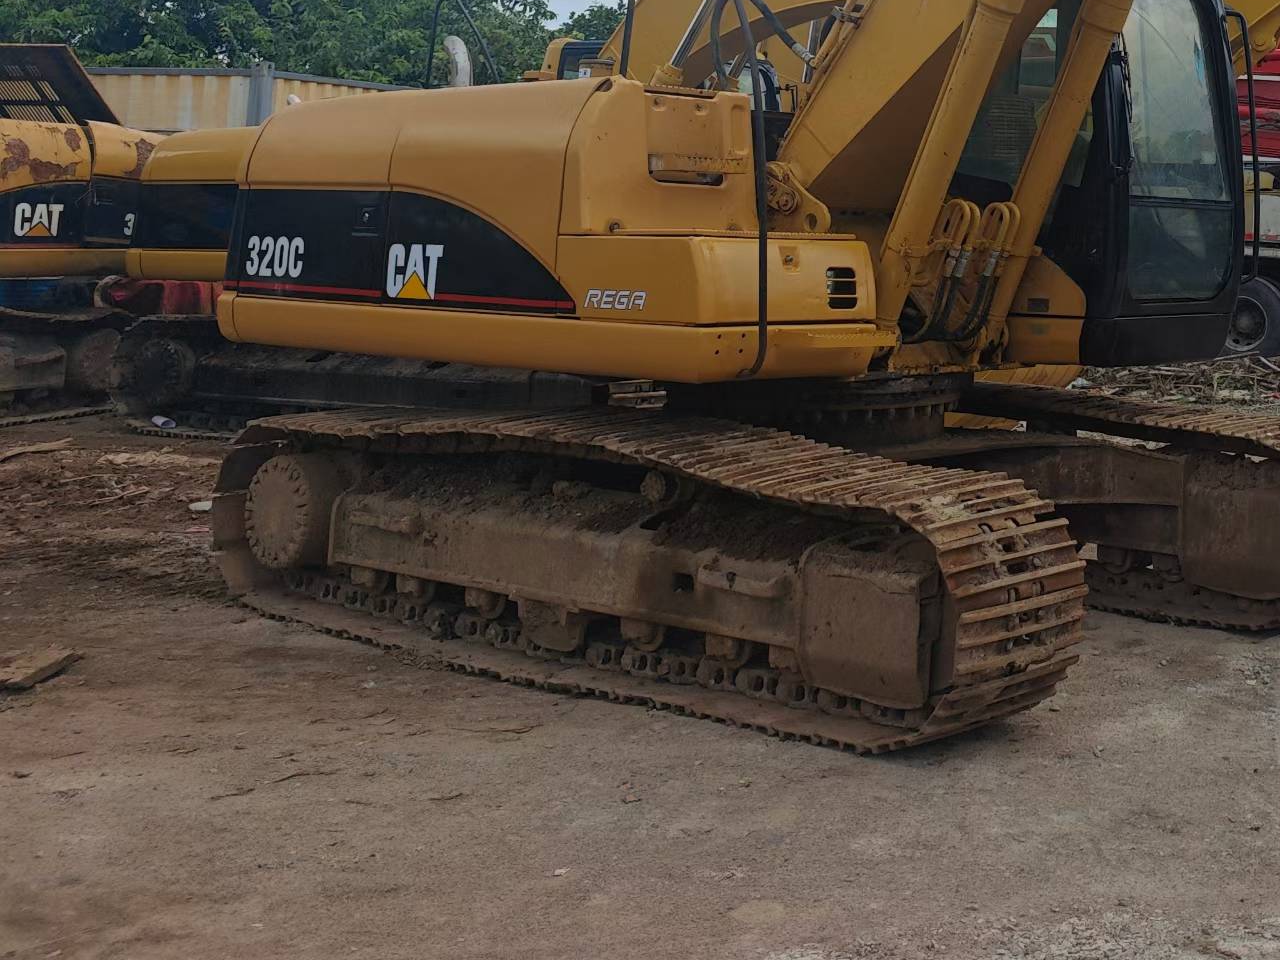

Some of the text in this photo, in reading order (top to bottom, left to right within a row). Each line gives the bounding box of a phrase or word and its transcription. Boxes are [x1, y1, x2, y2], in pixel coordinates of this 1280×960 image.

[13, 202, 64, 237] CAT
[123, 213, 136, 236] 3
[245, 235, 305, 278] 320C
[386, 243, 445, 300] CAT
[583, 289, 646, 310] REGA
